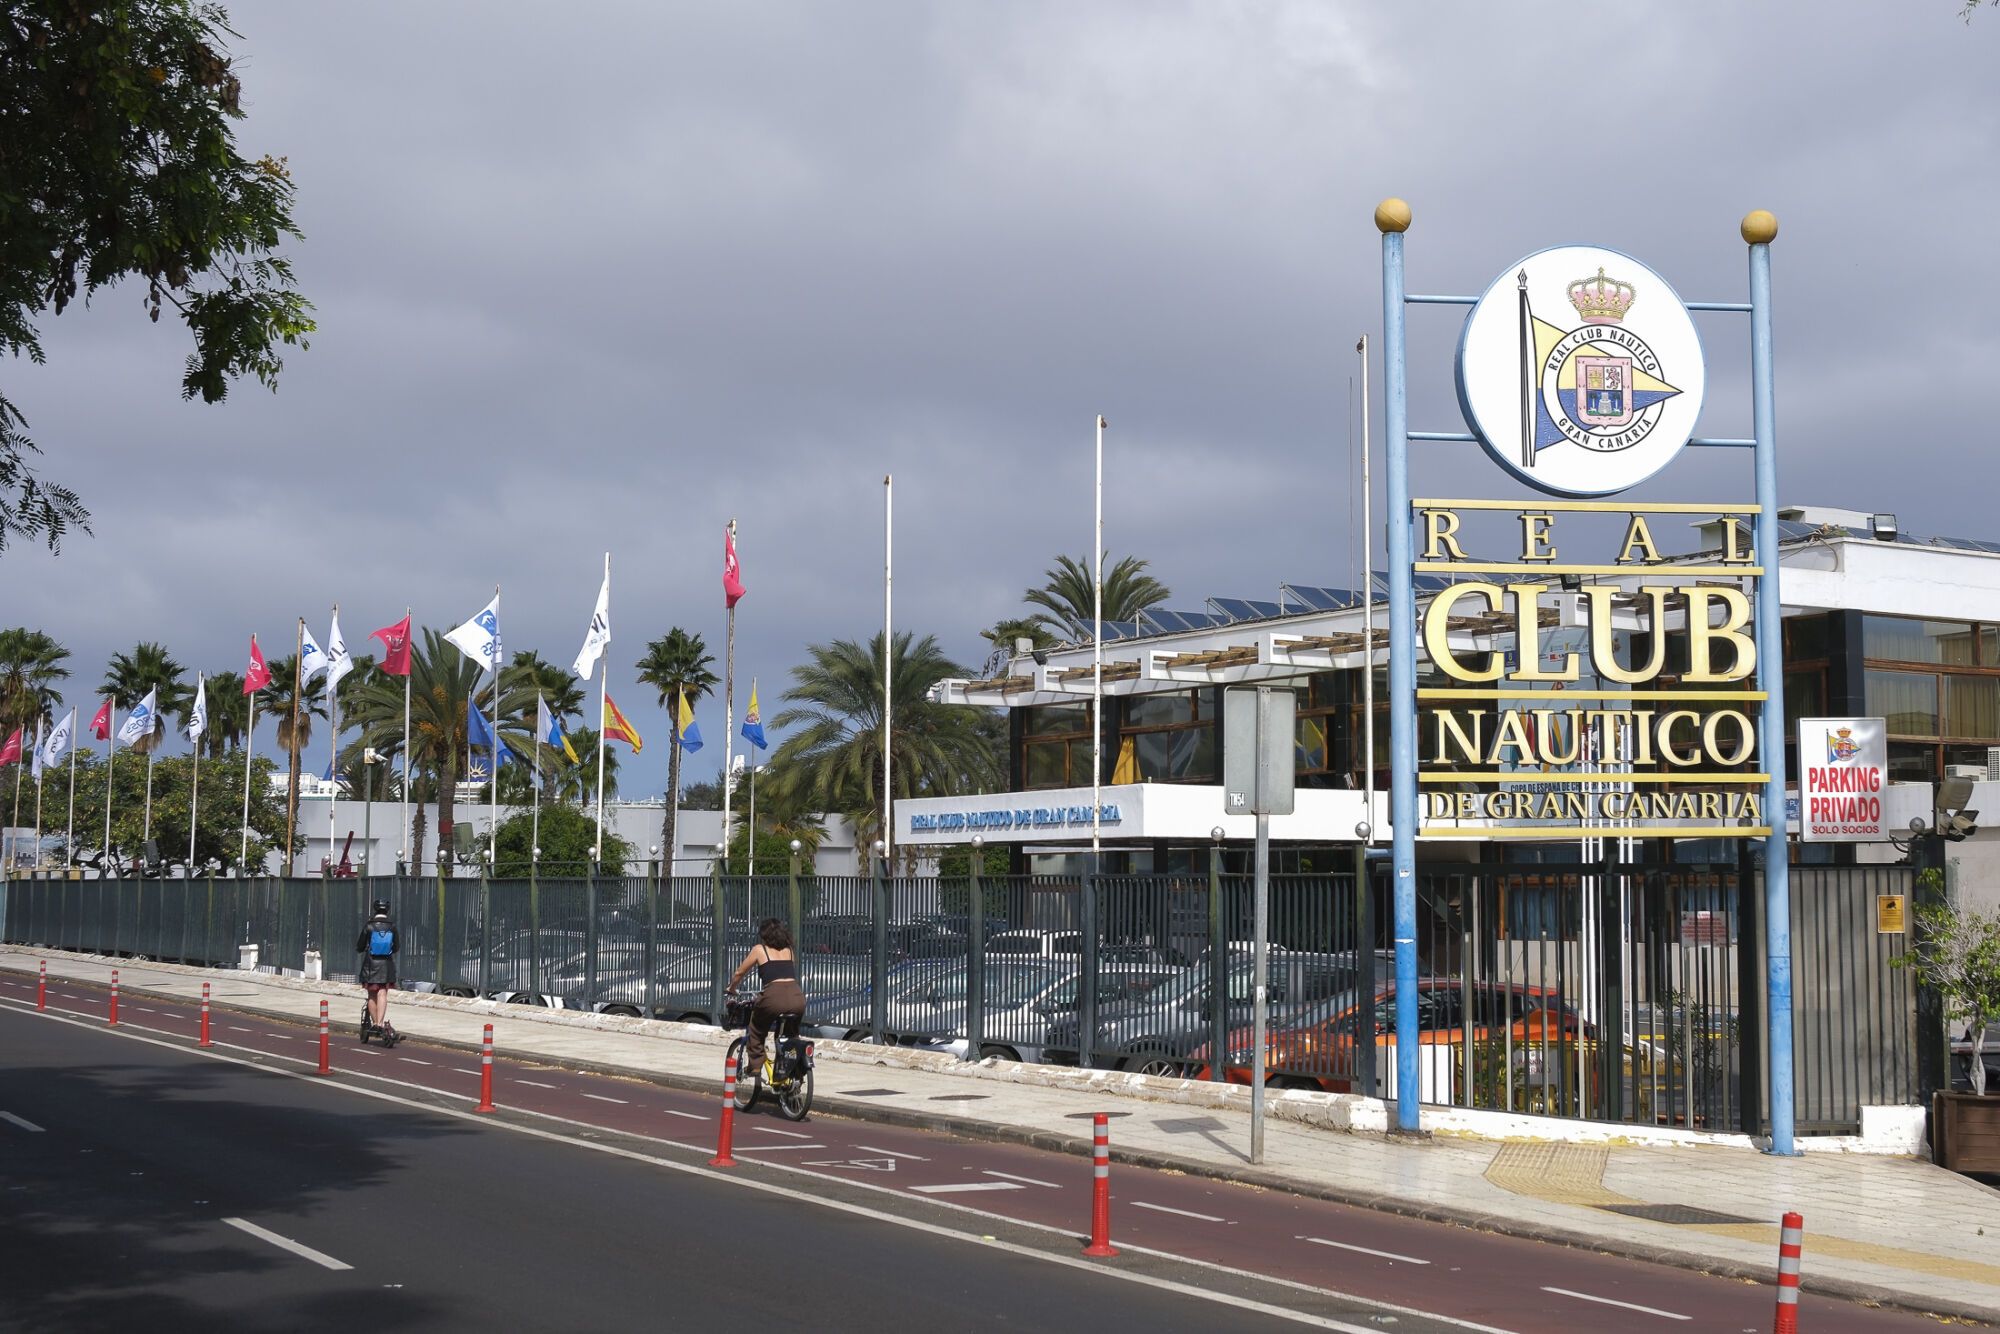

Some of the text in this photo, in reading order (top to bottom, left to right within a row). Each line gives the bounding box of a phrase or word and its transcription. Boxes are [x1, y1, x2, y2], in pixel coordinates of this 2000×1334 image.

[1548, 328, 1657, 372] REAL CLUB NAUTICO
[1558, 417, 1652, 449] GRAN CANARIA
[1421, 509, 1754, 563] REAL
[1423, 581, 1757, 683] CLUB
[1431, 709, 1756, 767] NAUTICO
[1808, 766, 1880, 793] PARKING
[1014, 809, 1032, 825] DE
[1032, 806, 1067, 824] GRAN
[1427, 791, 1481, 819] DE
[1484, 791, 1589, 819] GRAN
[1598, 791, 1762, 819] CANARIA
[1810, 797, 1881, 823] PRIVADO
[1811, 825, 1880, 835] SOLO SOCIOS
